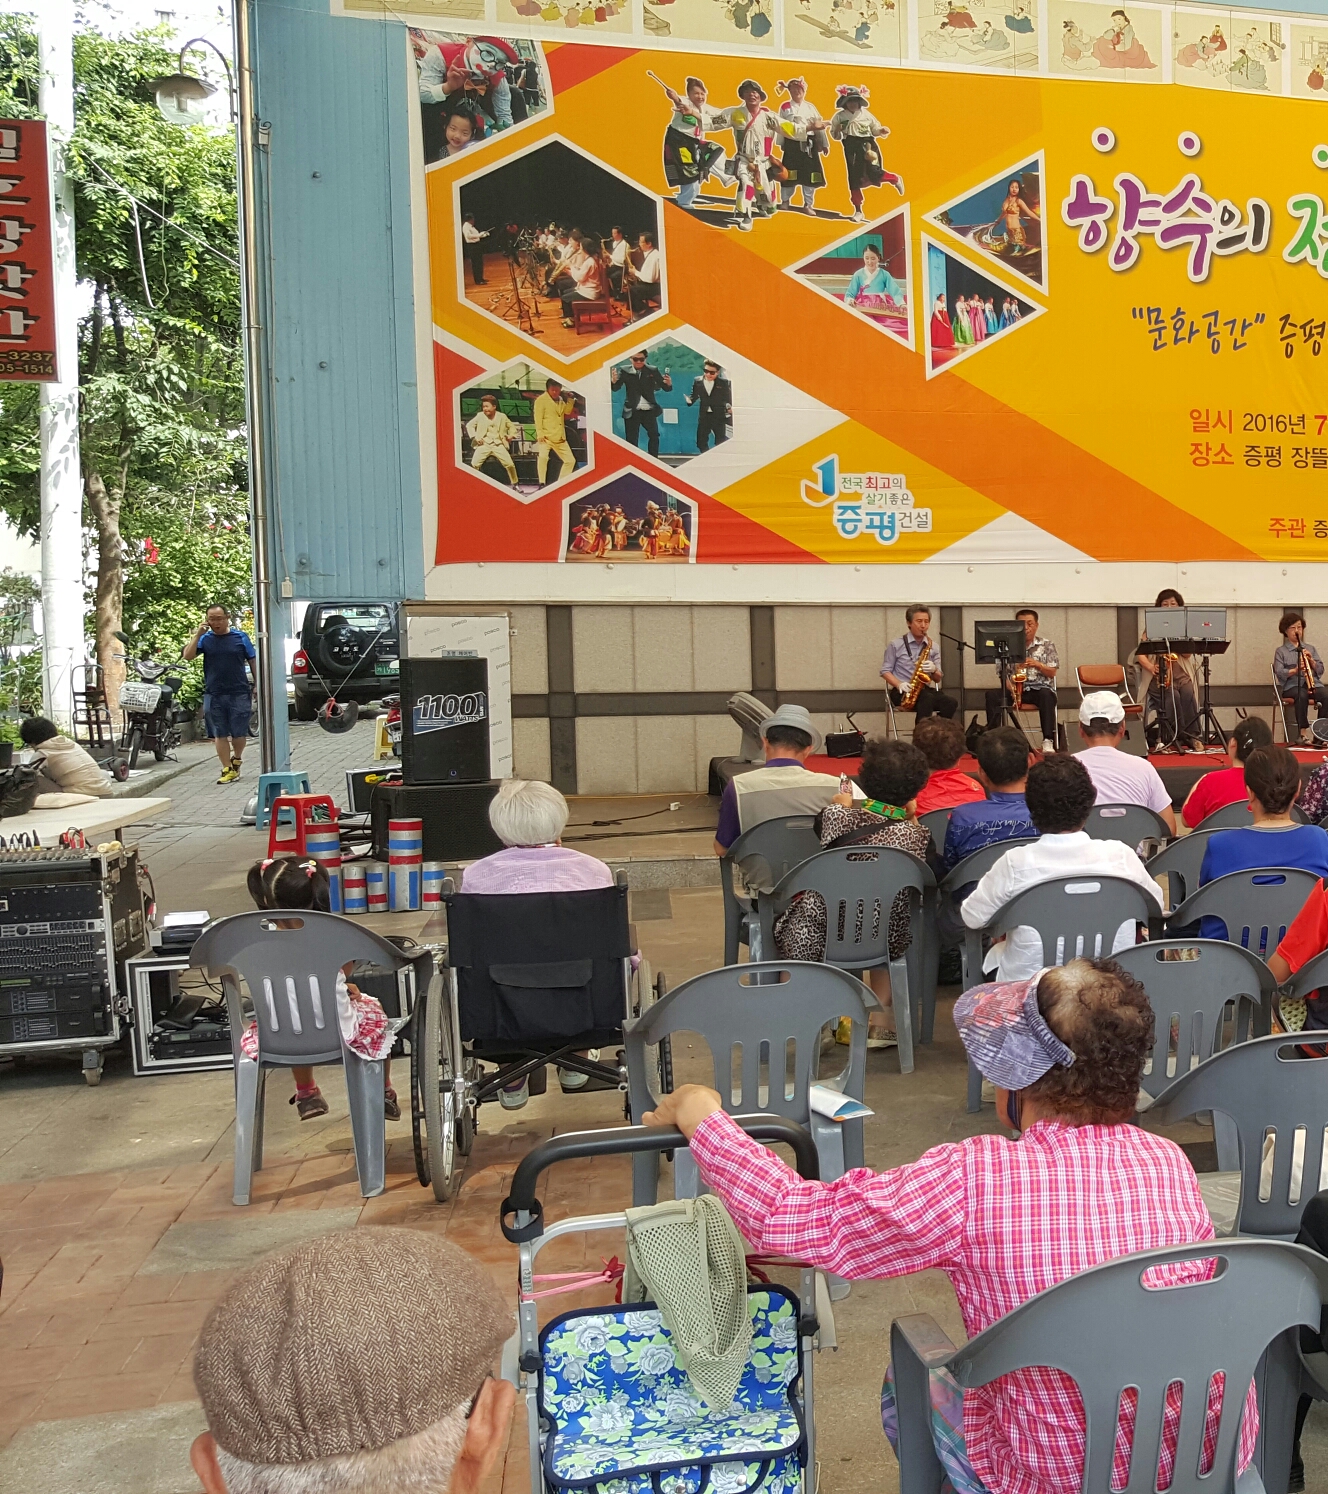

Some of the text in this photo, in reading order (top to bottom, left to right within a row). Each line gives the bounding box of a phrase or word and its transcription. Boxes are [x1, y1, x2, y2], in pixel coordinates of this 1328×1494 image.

[1063, 173, 1269, 281] 향수의
[1189, 409, 1233, 434] 일시
[1243, 413, 1307, 435] 2016년
[1189, 442, 1235, 468] 장소
[1243, 445, 1283, 468] 증평
[866, 493, 911, 505] 살기좋은
[1268, 517, 1306, 538] 주관
[417, 693, 478, 719] 1100
[455, 715, 479, 723] WATTS
